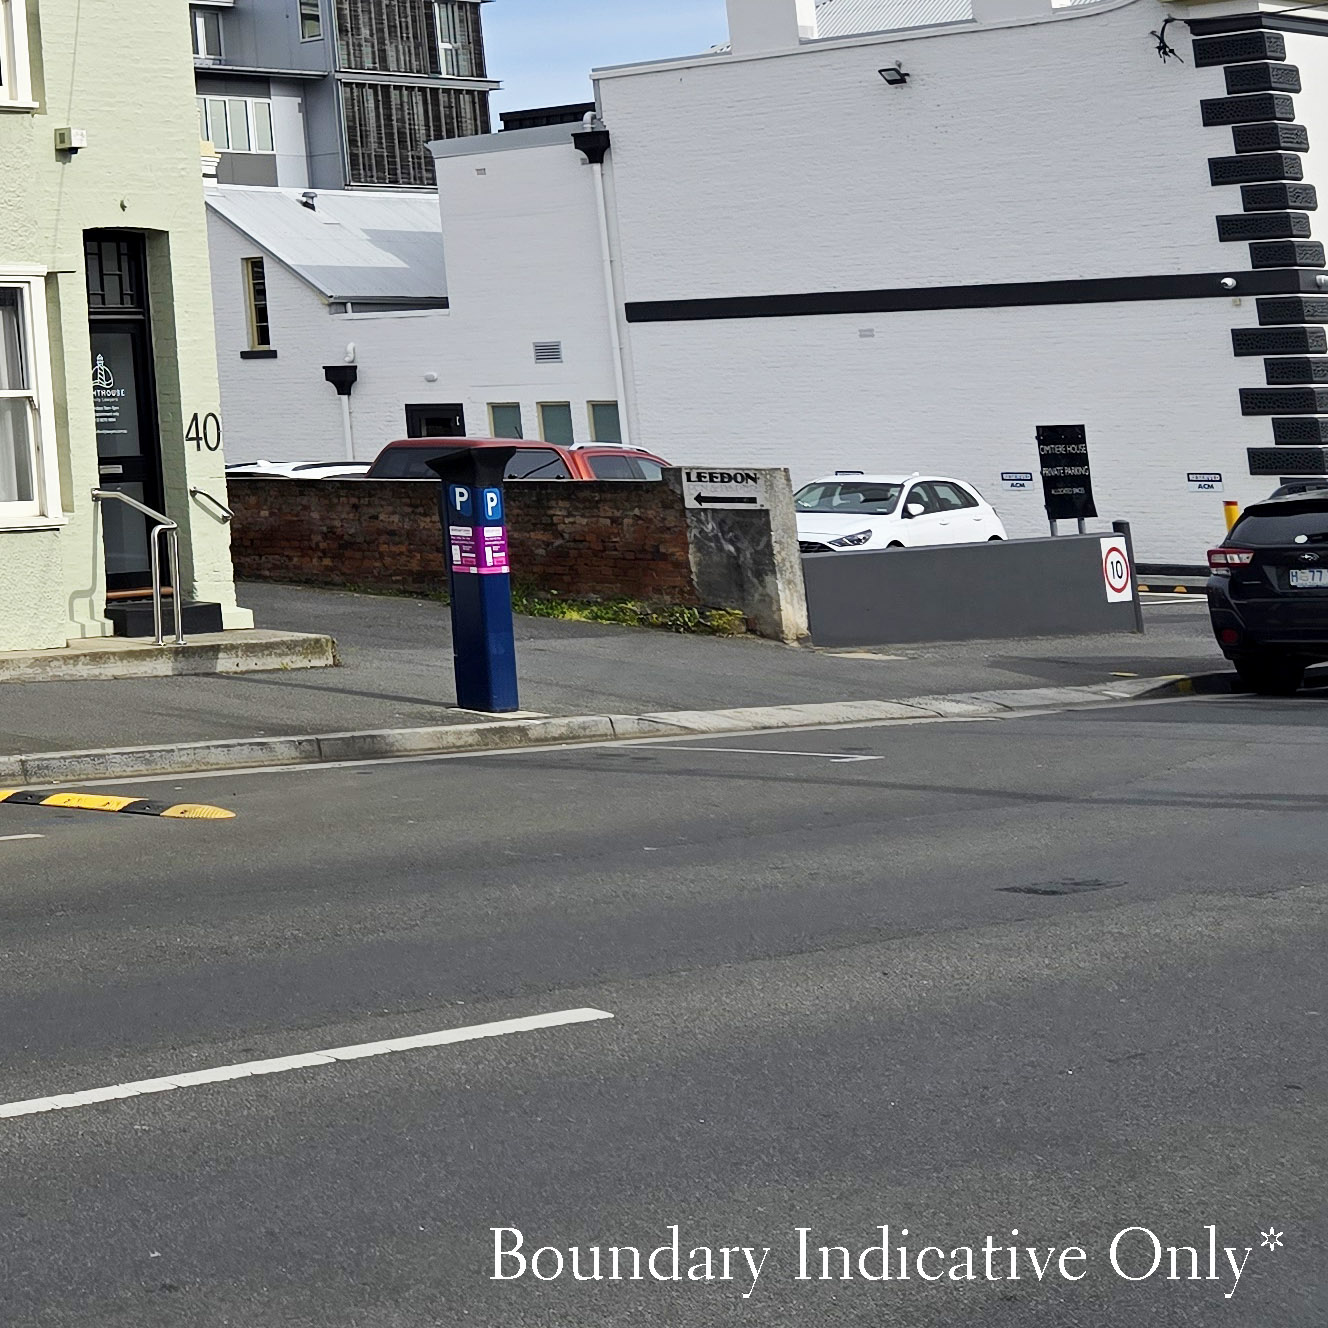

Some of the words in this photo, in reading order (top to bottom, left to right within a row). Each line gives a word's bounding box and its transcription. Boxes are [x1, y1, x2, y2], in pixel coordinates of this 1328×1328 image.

[185, 412, 221, 451] 40
[1067, 444, 1087, 453] HOUSE
[685, 472, 758, 484] LEEDON
[1042, 467, 1064, 477] PRIVATE
[1064, 466, 1089, 475] PARKING
[455, 487, 469, 510] P
[486, 492, 498, 516] P
[1110, 560, 1124, 579] 10
